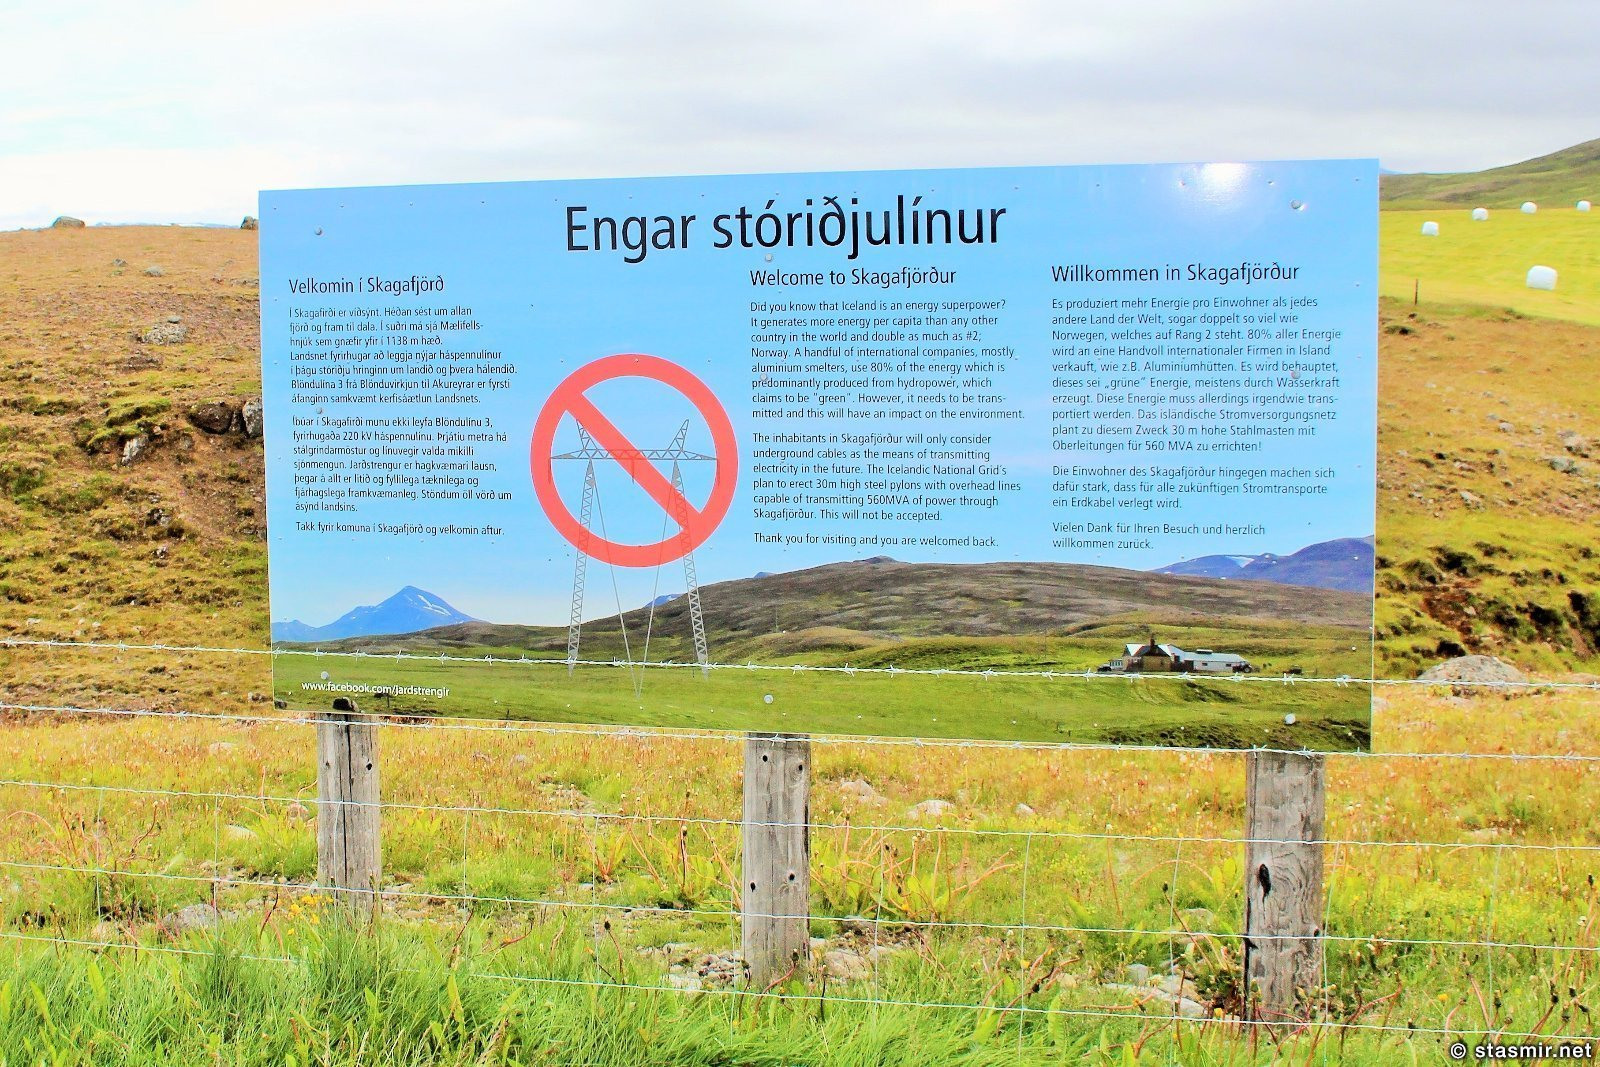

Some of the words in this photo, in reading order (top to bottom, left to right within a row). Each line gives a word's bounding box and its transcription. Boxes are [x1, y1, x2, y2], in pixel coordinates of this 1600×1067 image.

[566, 206, 696, 263] Engar
[712, 195, 1006, 260] stóriðjulínur
[749, 269, 824, 286] Welcome
[829, 269, 846, 285] to
[851, 268, 956, 289] Skagafjörður
[1051, 265, 1159, 282] Willkommen
[1166, 265, 1180, 281] in
[1187, 264, 1299, 285] Skagafjörður
[288, 277, 354, 294] Velkomin
[367, 276, 444, 297] Skagafjörð
[750, 301, 767, 312] Did
[769, 304, 787, 314] you
[789, 300, 816, 311] know
[818, 300, 838, 311] that
[841, 300, 877, 311] Iceland
[879, 300, 887, 310] is
[890, 302, 902, 310] an
[905, 302, 939, 313] energy
[941, 298, 1006, 312] superpower?
[1052, 298, 1063, 309] Es
[1066, 298, 1118, 311] produziert
[1121, 298, 1148, 308] mehr
[1151, 297, 1190, 311] Energie
[1192, 300, 1210, 310] pro
[1213, 297, 1269, 308] Einwohner
[1272, 297, 1287, 307] als
[1290, 296, 1318, 310] jedes
[750, 316, 758, 327] It
[760, 316, 808, 330] generates
[837, 318, 870, 329] energy
[873, 318, 889, 329] per
[892, 315, 922, 328] capita
[925, 315, 948, 326] than
[950, 318, 968, 328] any
[971, 314, 998, 325] other
[751, 346, 791, 360] Norway.
[804, 346, 841, 357] handful
[843, 346, 854, 357] of
[856, 346, 919, 357] international
[922, 346, 978, 359] companies,
[981, 346, 1014, 359] mostly
[1051, 345, 1075, 356] wird
[1077, 348, 1090, 356] an
[1093, 345, 1115, 356] eine
[1118, 345, 1163, 356] Handvoll
[1167, 345, 1243, 356] internationaler
[1247, 345, 1282, 356] Firmen
[1286, 345, 1296, 355] in
[1299, 345, 1331, 355] Island
[751, 377, 821, 390] predominantly
[823, 377, 869, 390] produced
[871, 377, 894, 388] from
[897, 377, 959, 390] hydropower,
[962, 377, 992, 387] which
[1052, 408, 1090, 422] portiert
[1092, 409, 1135, 419] werden.
[1137, 409, 1157, 419] Das
[1160, 409, 1216, 419] isländische
[1219, 409, 1336, 422] Stromversorgungsnetz
[752, 432, 770, 443] The
[772, 432, 826, 443] inhabitants
[829, 433, 838, 443] in
[841, 433, 902, 446] Skagafjörður
[905, 433, 923, 444] will
[926, 433, 947, 446] only
[949, 433, 991, 444] consider
[1052, 440, 1124, 454] Oberleitungen
[1127, 440, 1142, 451] für
[1145, 440, 1165, 451] 560
[1168, 441, 1194, 451] MVA
[1211, 441, 1261, 452] errichten!
[752, 448, 814, 461] underground
[816, 448, 847, 459] cables
[849, 451, 861, 459] as
[863, 448, 879, 459] the
[882, 451, 914, 459] means
[916, 449, 927, 459] of
[930, 449, 990, 462] transmitting
[1052, 481, 1079, 492] dafür
[1082, 482, 1111, 494] stark,
[1113, 482, 1136, 492] dass
[1139, 482, 1154, 493] für
[1156, 482, 1175, 493] alle
[1178, 482, 1239, 496] zukünftigen
[1242, 483, 1328, 497] Stromtransporte
[753, 493, 790, 506] capable
[792, 493, 802, 504] of
[805, 493, 864, 507] transmitting
[867, 494, 910, 505] 560MVA
[912, 494, 923, 505] of
[925, 497, 956, 508] power
[959, 495, 999, 508] through
[1052, 497, 1068, 508] ein
[1071, 497, 1115, 508] Erdkabel
[1117, 497, 1153, 511] verlegt
[1156, 498, 1182, 509] wird.
[1052, 522, 1084, 533] Vielen
[1087, 522, 1113, 533] Dank
[1116, 523, 1130, 534] für
[1134, 523, 1160, 534] Ihren
[1163, 523, 1199, 534] Besuch
[1202, 524, 1222, 535] und
[1225, 524, 1265, 535] herzlich
[1052, 538, 1114, 549] willkommen
[1117, 538, 1154, 549] zurück.
[301, 681, 450, 699] www.facebook.com/jardstrengir
